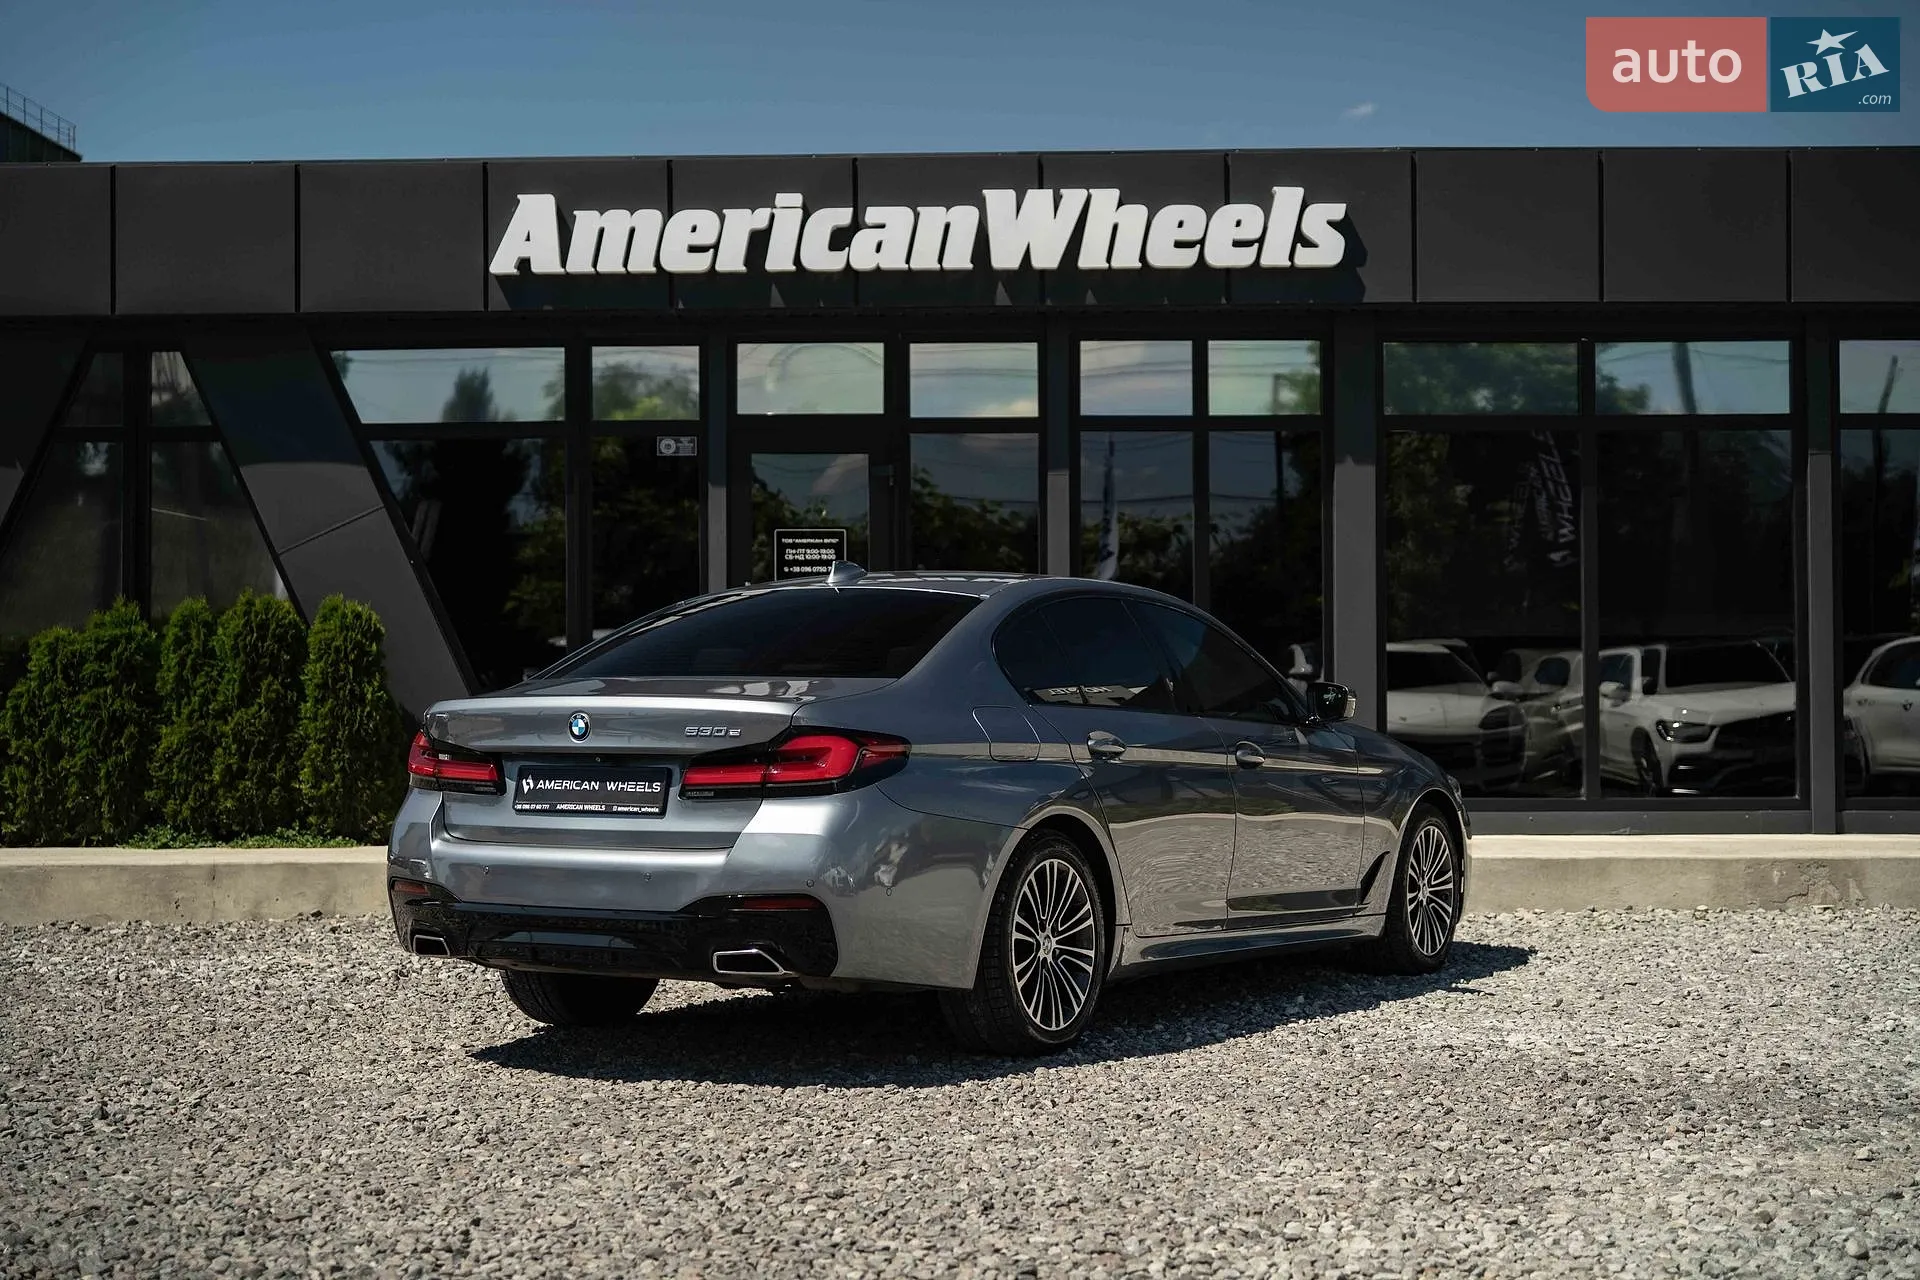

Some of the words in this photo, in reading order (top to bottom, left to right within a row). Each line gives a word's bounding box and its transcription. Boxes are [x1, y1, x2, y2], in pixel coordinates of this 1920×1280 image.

[536, 779, 600, 791] AMERICAN
[606, 781, 661, 793] WHEELS
[556, 803, 583, 811] AMERICAN
[583, 804, 606, 812] WHEELS
